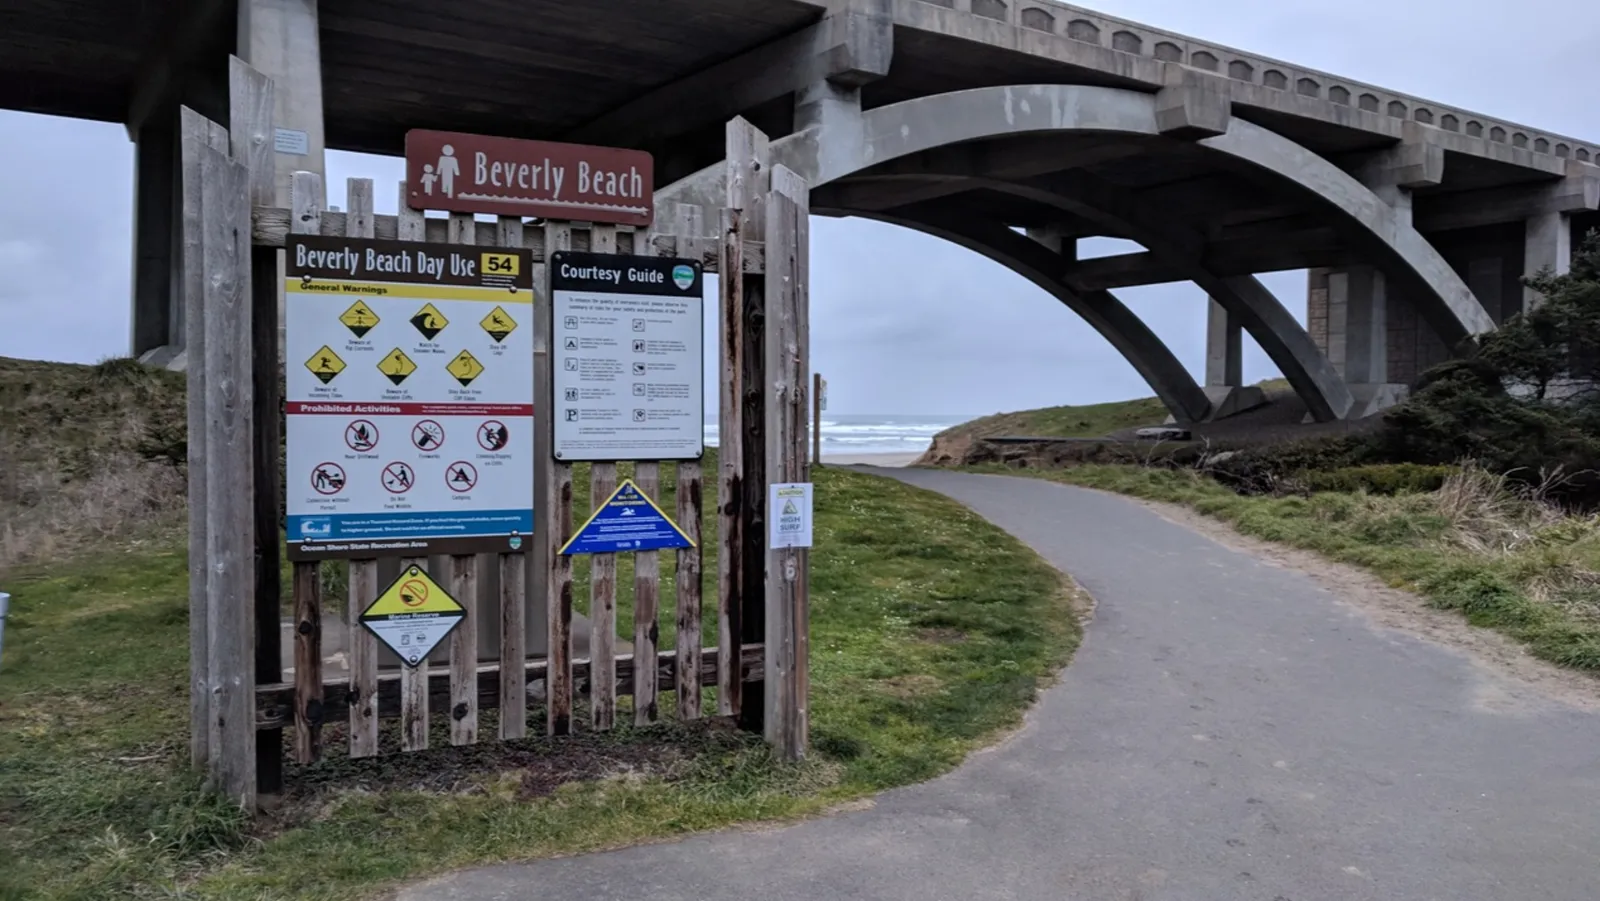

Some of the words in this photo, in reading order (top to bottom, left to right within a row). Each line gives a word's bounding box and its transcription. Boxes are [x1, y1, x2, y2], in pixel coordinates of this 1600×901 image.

[475, 151, 564, 199] Beverly
[578, 161, 642, 198] Beach
[296, 243, 359, 276] Beverly
[366, 248, 411, 273] Beach
[417, 251, 445, 280] Day
[450, 253, 475, 277] Use
[488, 256, 513, 272] 54
[561, 263, 621, 285] Courtesy
[628, 268, 664, 283] Guide
[300, 282, 340, 291] General
[343, 284, 388, 294] Warnings
[300, 404, 352, 412] Prohibited
[354, 405, 401, 413] Activities
